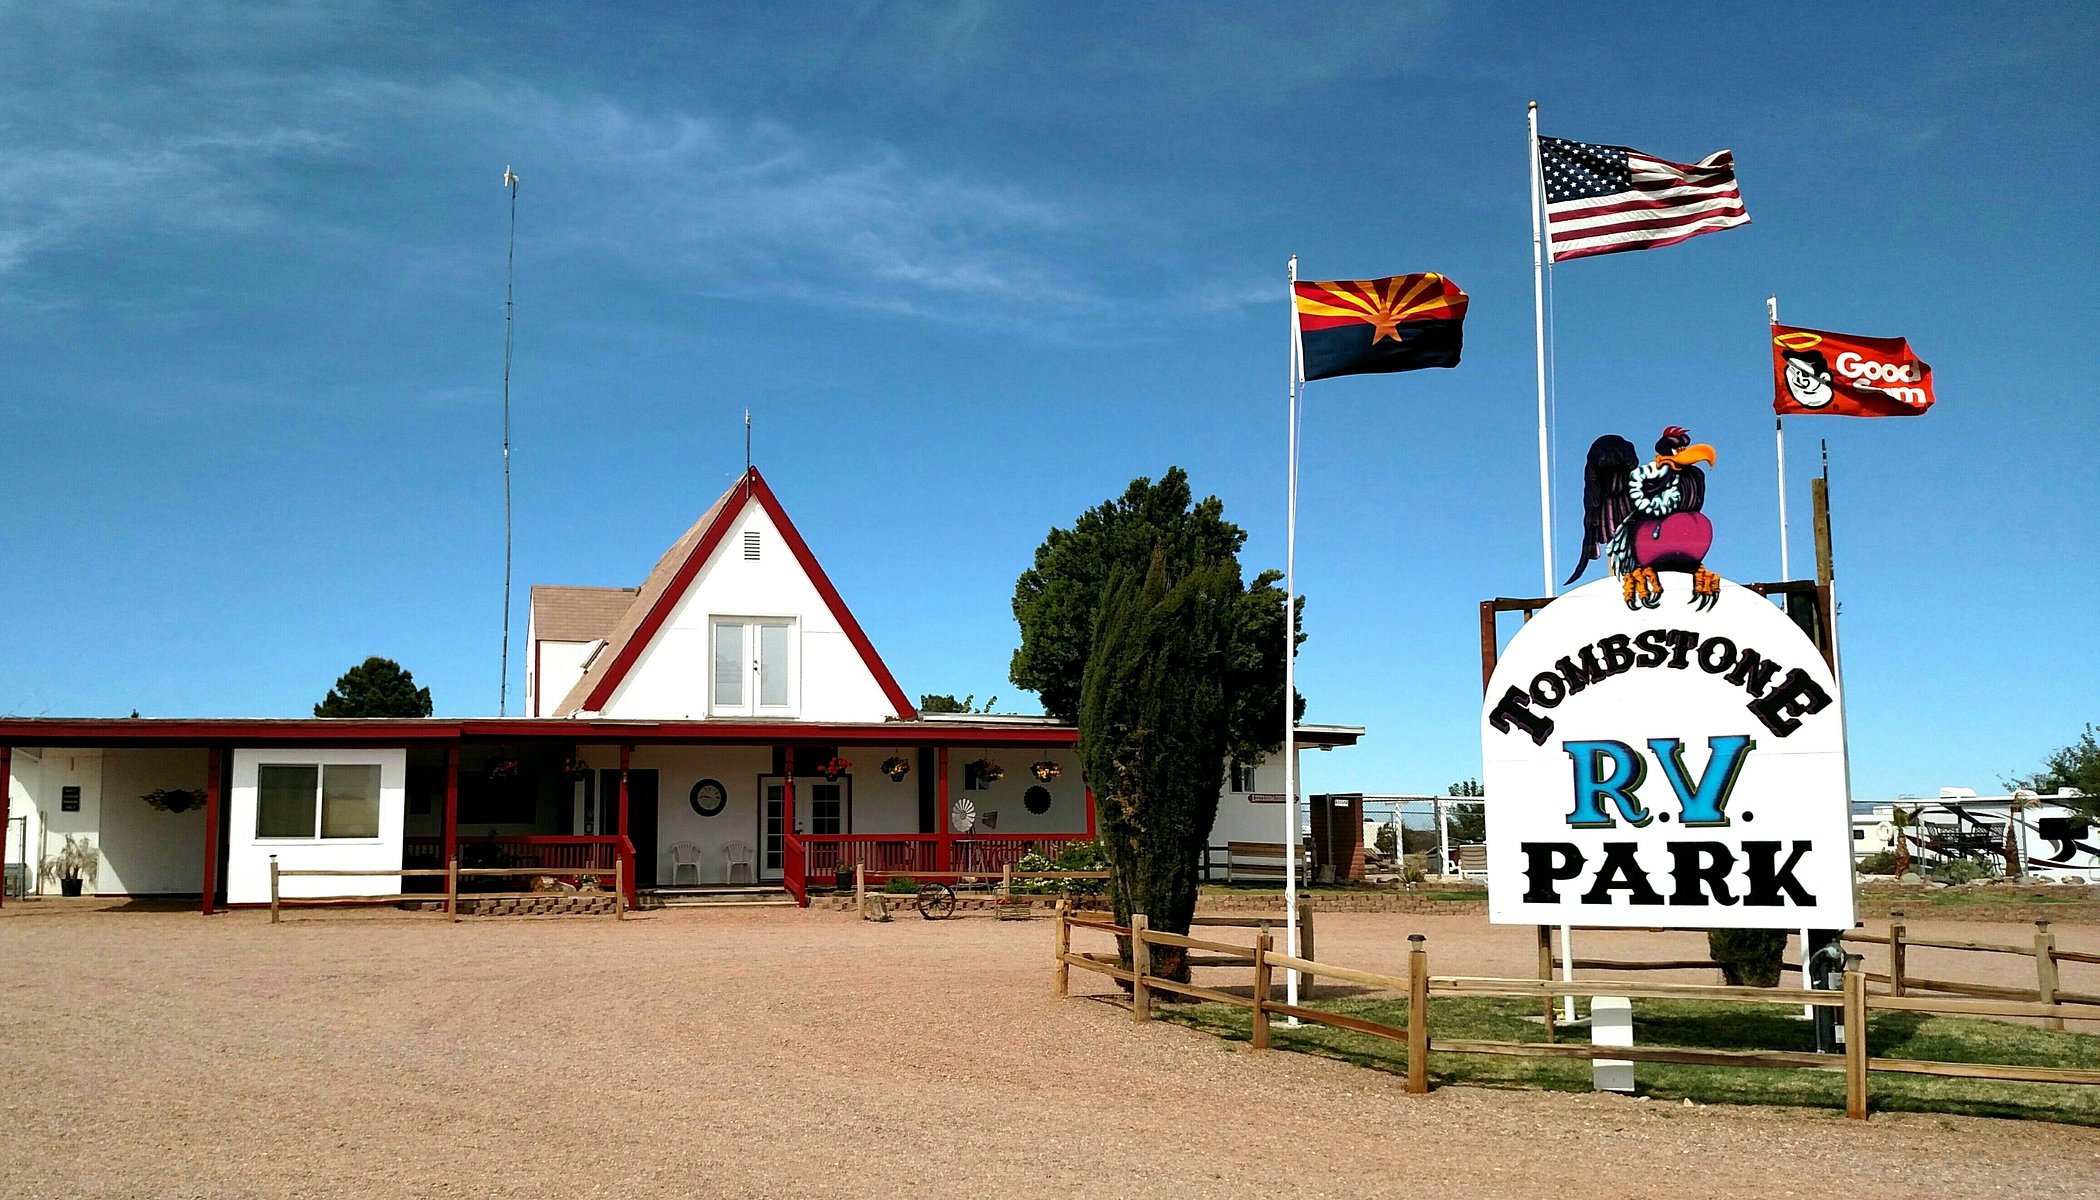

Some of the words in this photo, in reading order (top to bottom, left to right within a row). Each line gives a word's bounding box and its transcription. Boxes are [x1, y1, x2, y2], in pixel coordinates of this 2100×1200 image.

[1836, 352, 1921, 383] Good
[1489, 629, 1833, 746] TOMBSTONE
[1563, 735, 1757, 829] R.V.
[1521, 840, 1817, 906] PARK
